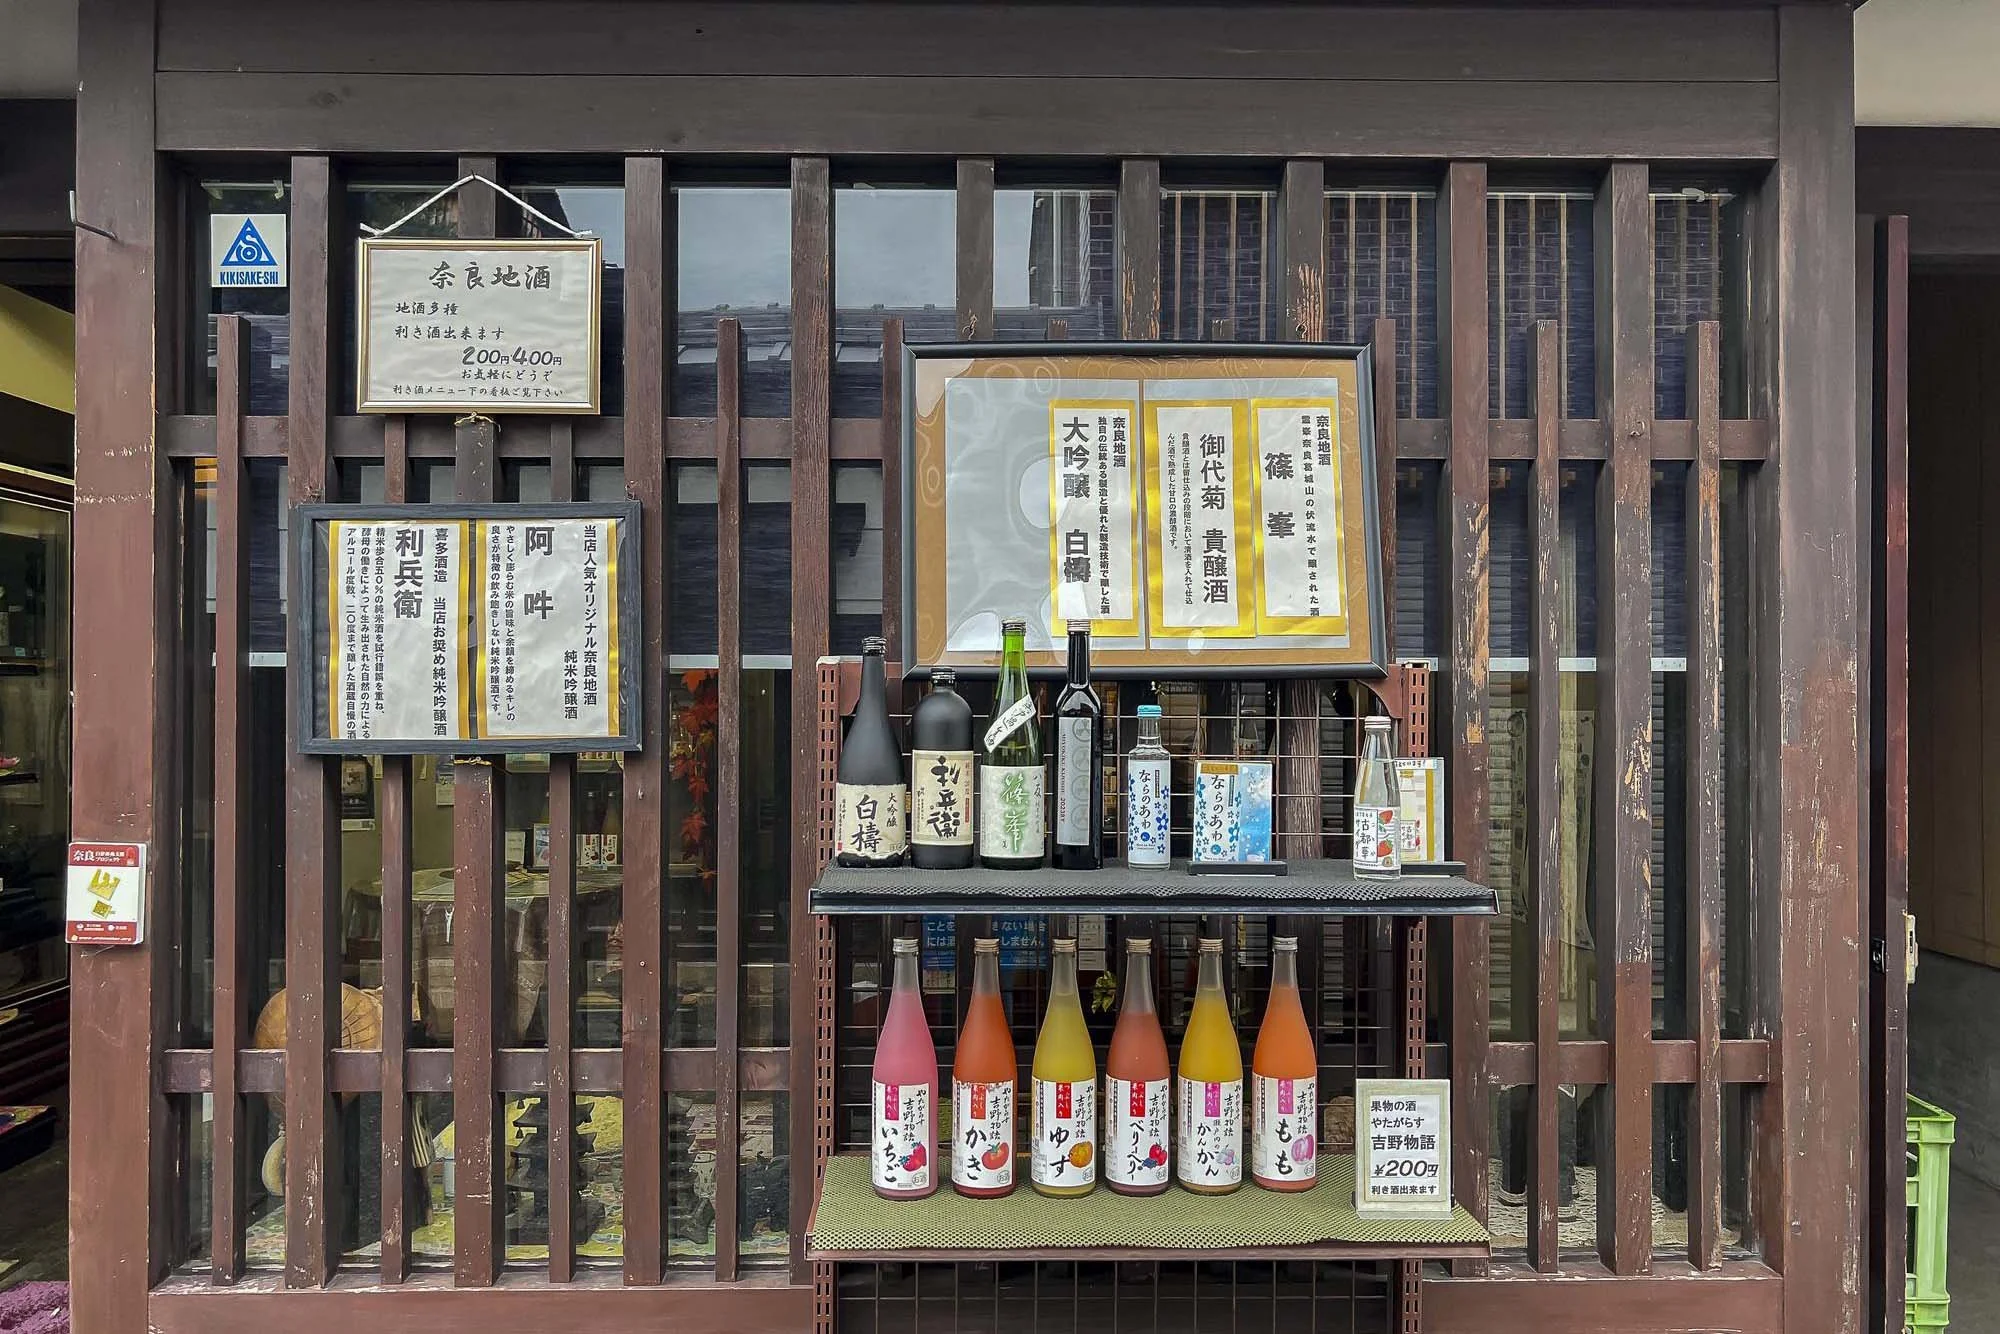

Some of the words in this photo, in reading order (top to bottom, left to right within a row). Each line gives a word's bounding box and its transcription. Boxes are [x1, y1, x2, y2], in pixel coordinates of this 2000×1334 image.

[219, 271, 279, 285] KIKISAKE-SHI
[428, 261, 551, 290] 奈良地酒
[394, 301, 460, 316] 地酒多種
[394, 326, 505, 340] 利き酒出来ます
[392, 384, 564, 398] 利き酒メニュー下の看板ご覧下さい
[461, 369, 553, 382] お気軽にどうぞ
[1062, 416, 1091, 499] 大吟醸
[1112, 416, 1127, 468] 奈良地酒
[1316, 415, 1331, 466] 奈良地酒
[1199, 433, 1226, 510] 御代菊
[393, 528, 424, 619] 利兵衛
[433, 527, 449, 583] 喜多酒造
[1201, 528, 1229, 604] 貴醸酒
[360, 527, 371, 739] 酵母の働きによって生み出された自然の力による
[490, 525, 501, 716] 良さが特徴の飲み飽きしない純米吟醸酒です。
[583, 524, 598, 706] 当店人気オリジナル奈良地酒
[432, 596, 448, 736] 当店お奨め純米吟醸酒
[563, 649, 578, 720] 純米吟醸酒
[1138, 769, 1152, 830] ならのあわ
[1209, 774, 1226, 842] ならのあわ
[73, 849, 95, 862] 奈良
[927, 921, 956, 932] ことを
[1370, 1100, 1417, 1112] 果物の酒
[1370, 1116, 1425, 1129] やたがらす
[881, 1127, 900, 1183] いちご
[965, 1125, 987, 1181] かき
[1275, 1118, 1293, 1175] もも
[1370, 1134, 1436, 1151] 吉野物語
[1373, 1159, 1439, 1178] ¥200円
[1371, 1185, 1437, 1195] 利き酒出来ます
